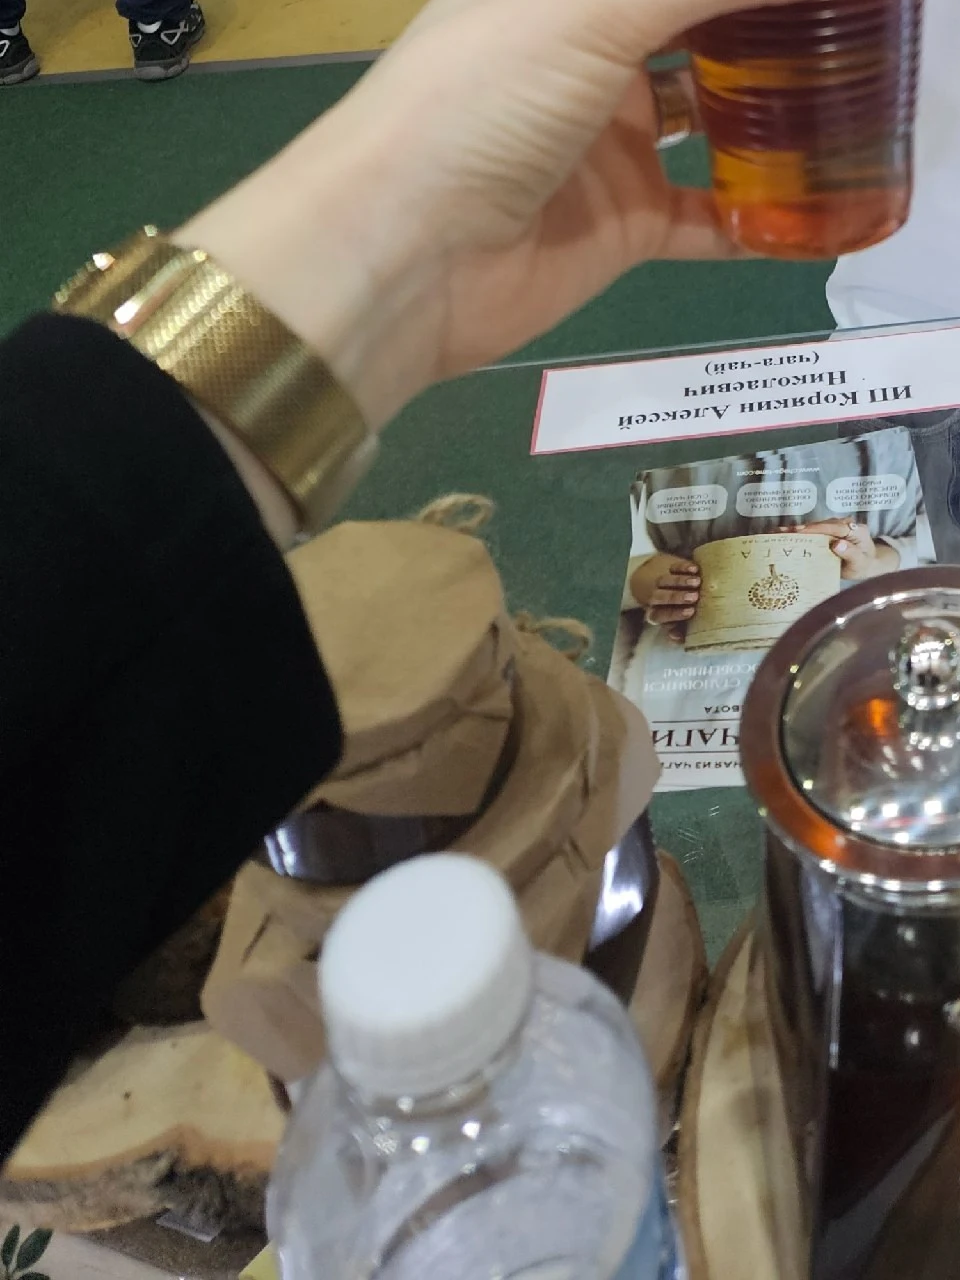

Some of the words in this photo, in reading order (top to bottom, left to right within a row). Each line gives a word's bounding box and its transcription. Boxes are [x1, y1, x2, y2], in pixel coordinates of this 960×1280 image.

[703, 350, 821, 376] (чага-чай)
[682, 370, 848, 398] Николаевич
[868, 384, 913, 404] ИП
[739, 389, 860, 415] Корякин
[617, 404, 730, 430] Алексей
[740, 548, 812, 560] ЧАГА
[651, 728, 740, 747] ЧАГИ
